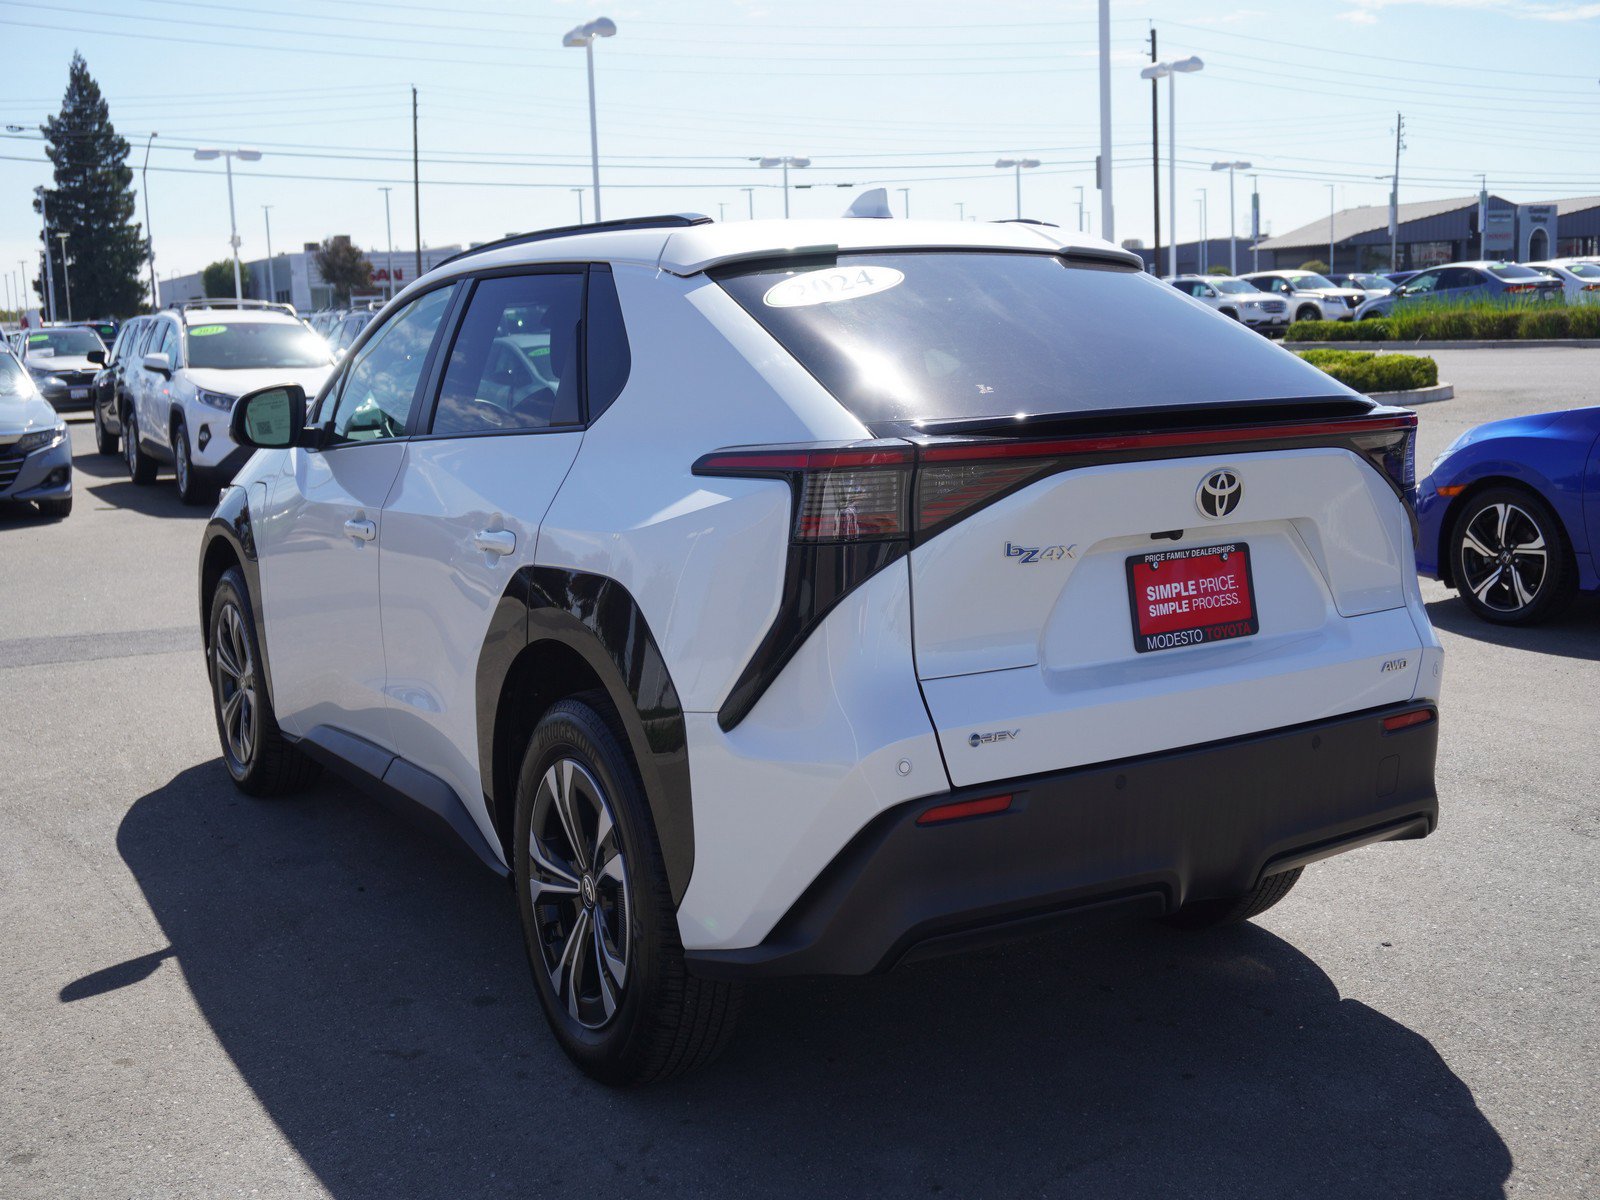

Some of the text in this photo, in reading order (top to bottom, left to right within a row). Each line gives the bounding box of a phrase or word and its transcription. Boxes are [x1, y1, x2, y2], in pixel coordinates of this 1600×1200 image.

[787, 269, 874, 297] 2024
[1144, 544, 1236, 563] PRICE FAMILY DEALERSHIPS
[1146, 574, 1239, 601] SIMPLE PRICE.
[1148, 592, 1241, 617] SIMPLE PROCESS.
[1146, 622, 1252, 650] MODESTO TOYOTA
[1380, 657, 1407, 672] AWD
